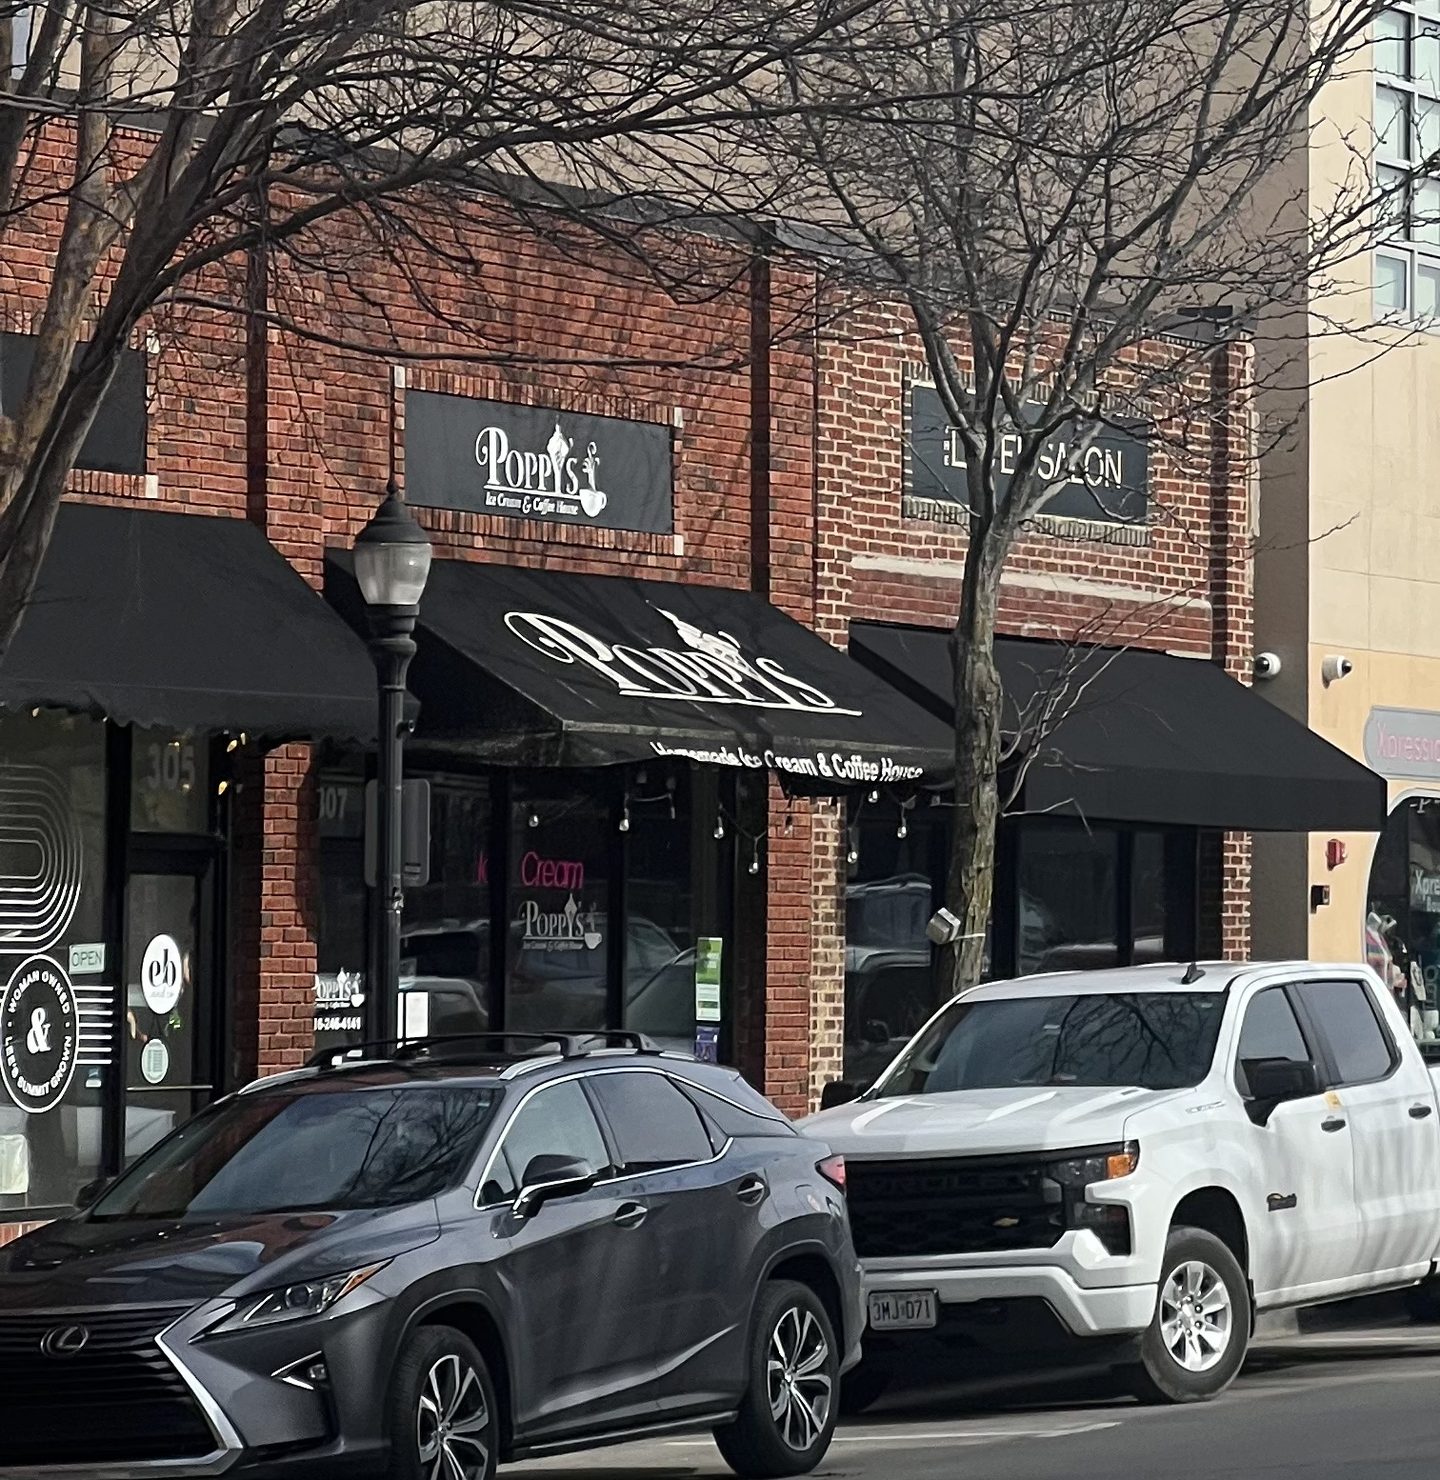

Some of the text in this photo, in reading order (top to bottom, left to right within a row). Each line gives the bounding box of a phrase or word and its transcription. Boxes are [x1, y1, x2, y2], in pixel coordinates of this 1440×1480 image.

[522, 495, 532, 514] &
[816, 752, 834, 777] &
[831, 753, 889, 782] Coffee
[521, 851, 584, 889] Cream
[71, 951, 102, 968] OPEN
[7, 970, 71, 1015] WOMAN OWNED
[5, 1036, 19, 1079] LEE'S
[16, 1075, 50, 1098] SUMMIT
